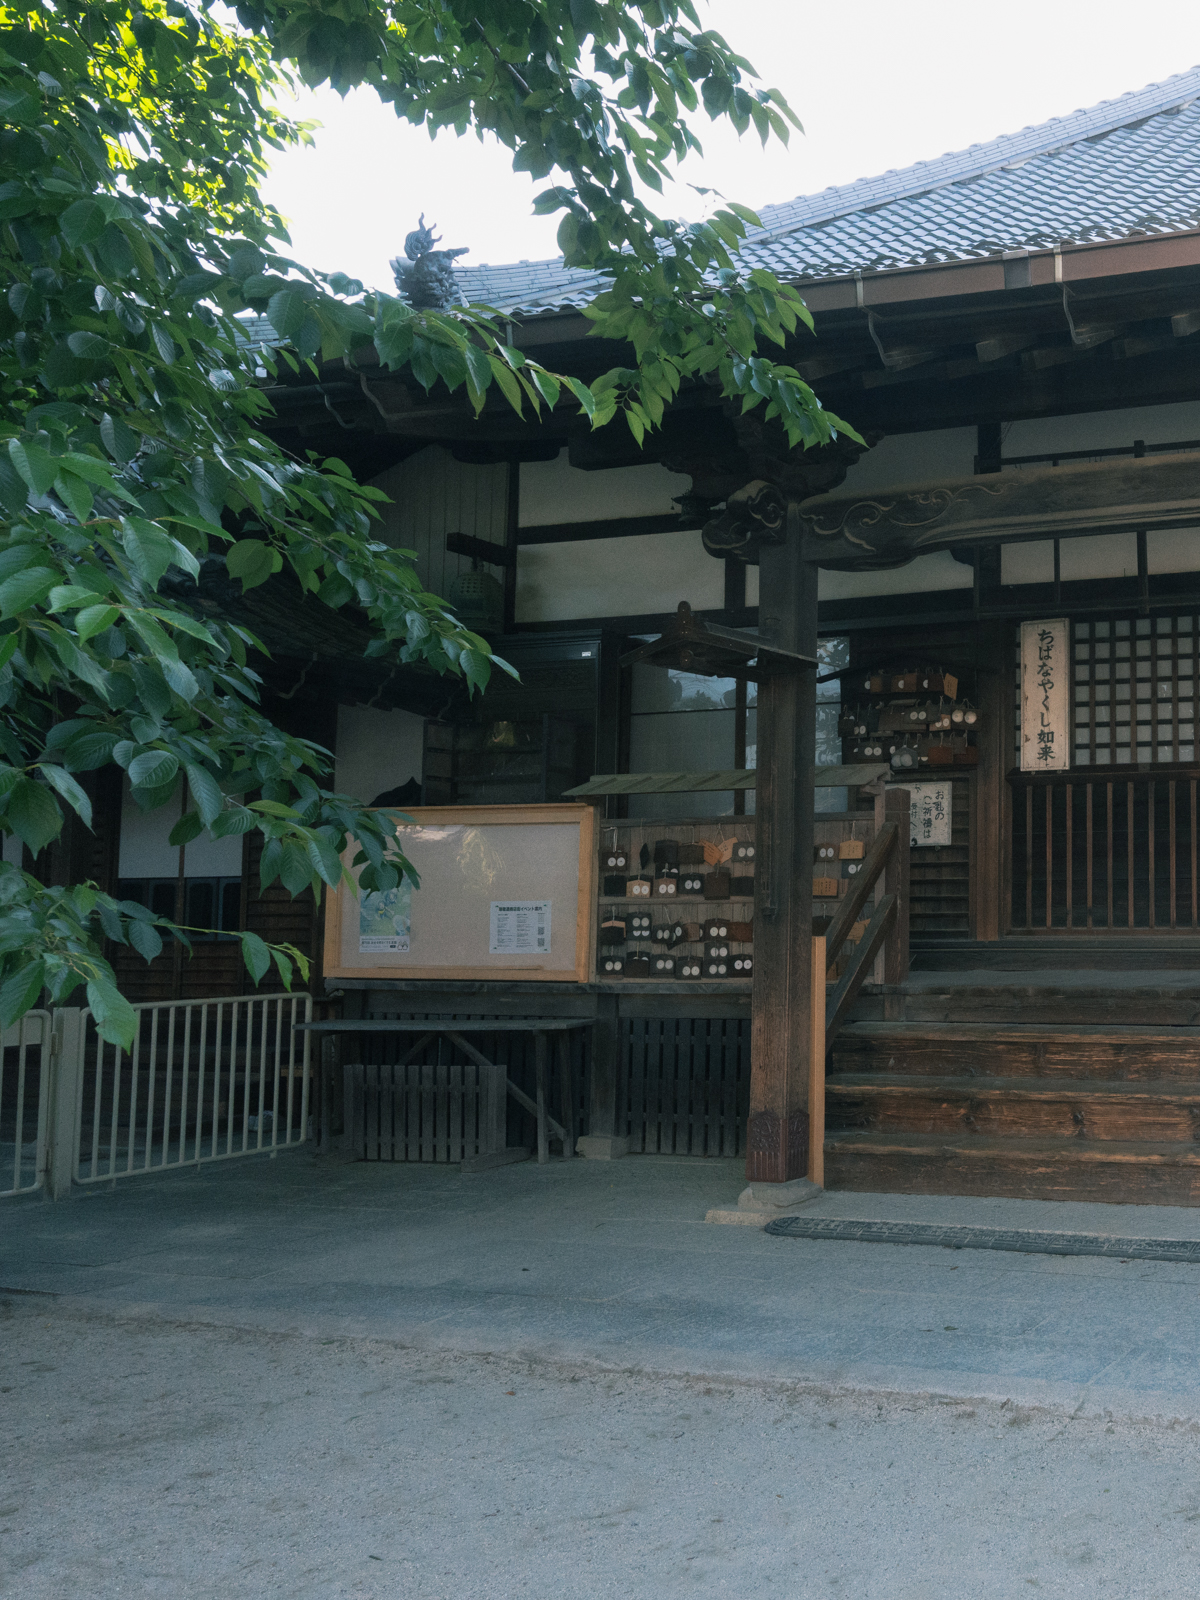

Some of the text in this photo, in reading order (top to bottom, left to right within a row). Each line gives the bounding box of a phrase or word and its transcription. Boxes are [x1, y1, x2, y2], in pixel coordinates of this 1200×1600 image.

[1037, 629, 1056, 761] ちばなやくし如来
[932, 790, 945, 821] お乳の
